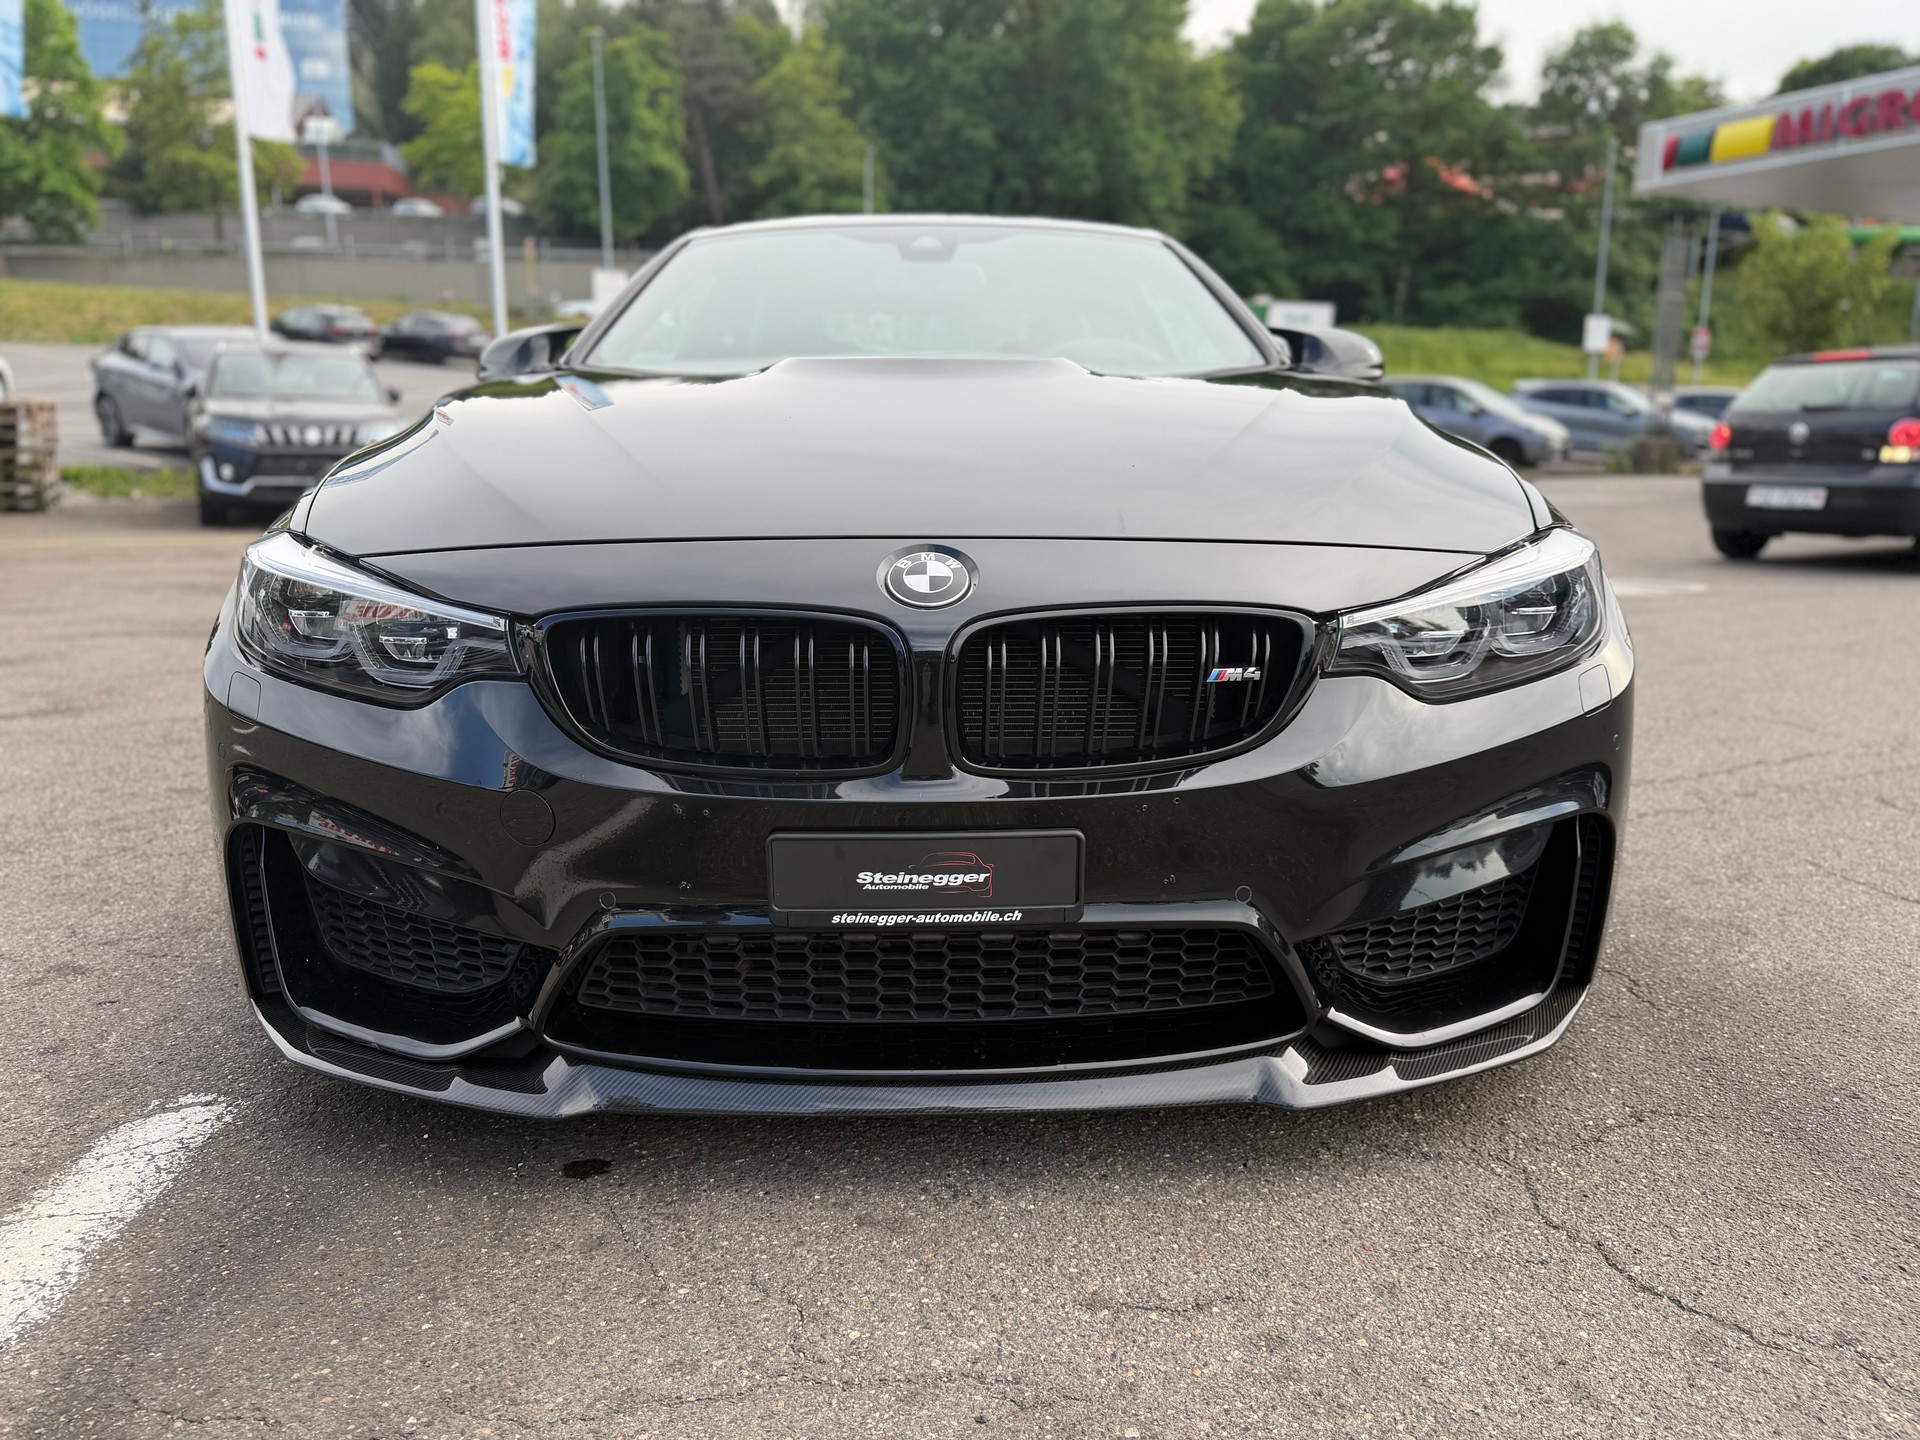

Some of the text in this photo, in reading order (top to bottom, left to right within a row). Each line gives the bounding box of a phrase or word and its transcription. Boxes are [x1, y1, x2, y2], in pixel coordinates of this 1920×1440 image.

[896, 553, 962, 569] BMW
[1216, 667, 1261, 682] M4
[856, 871, 991, 886] Steinegger
[831, 910, 1023, 926] steinegger-automobile.ch
